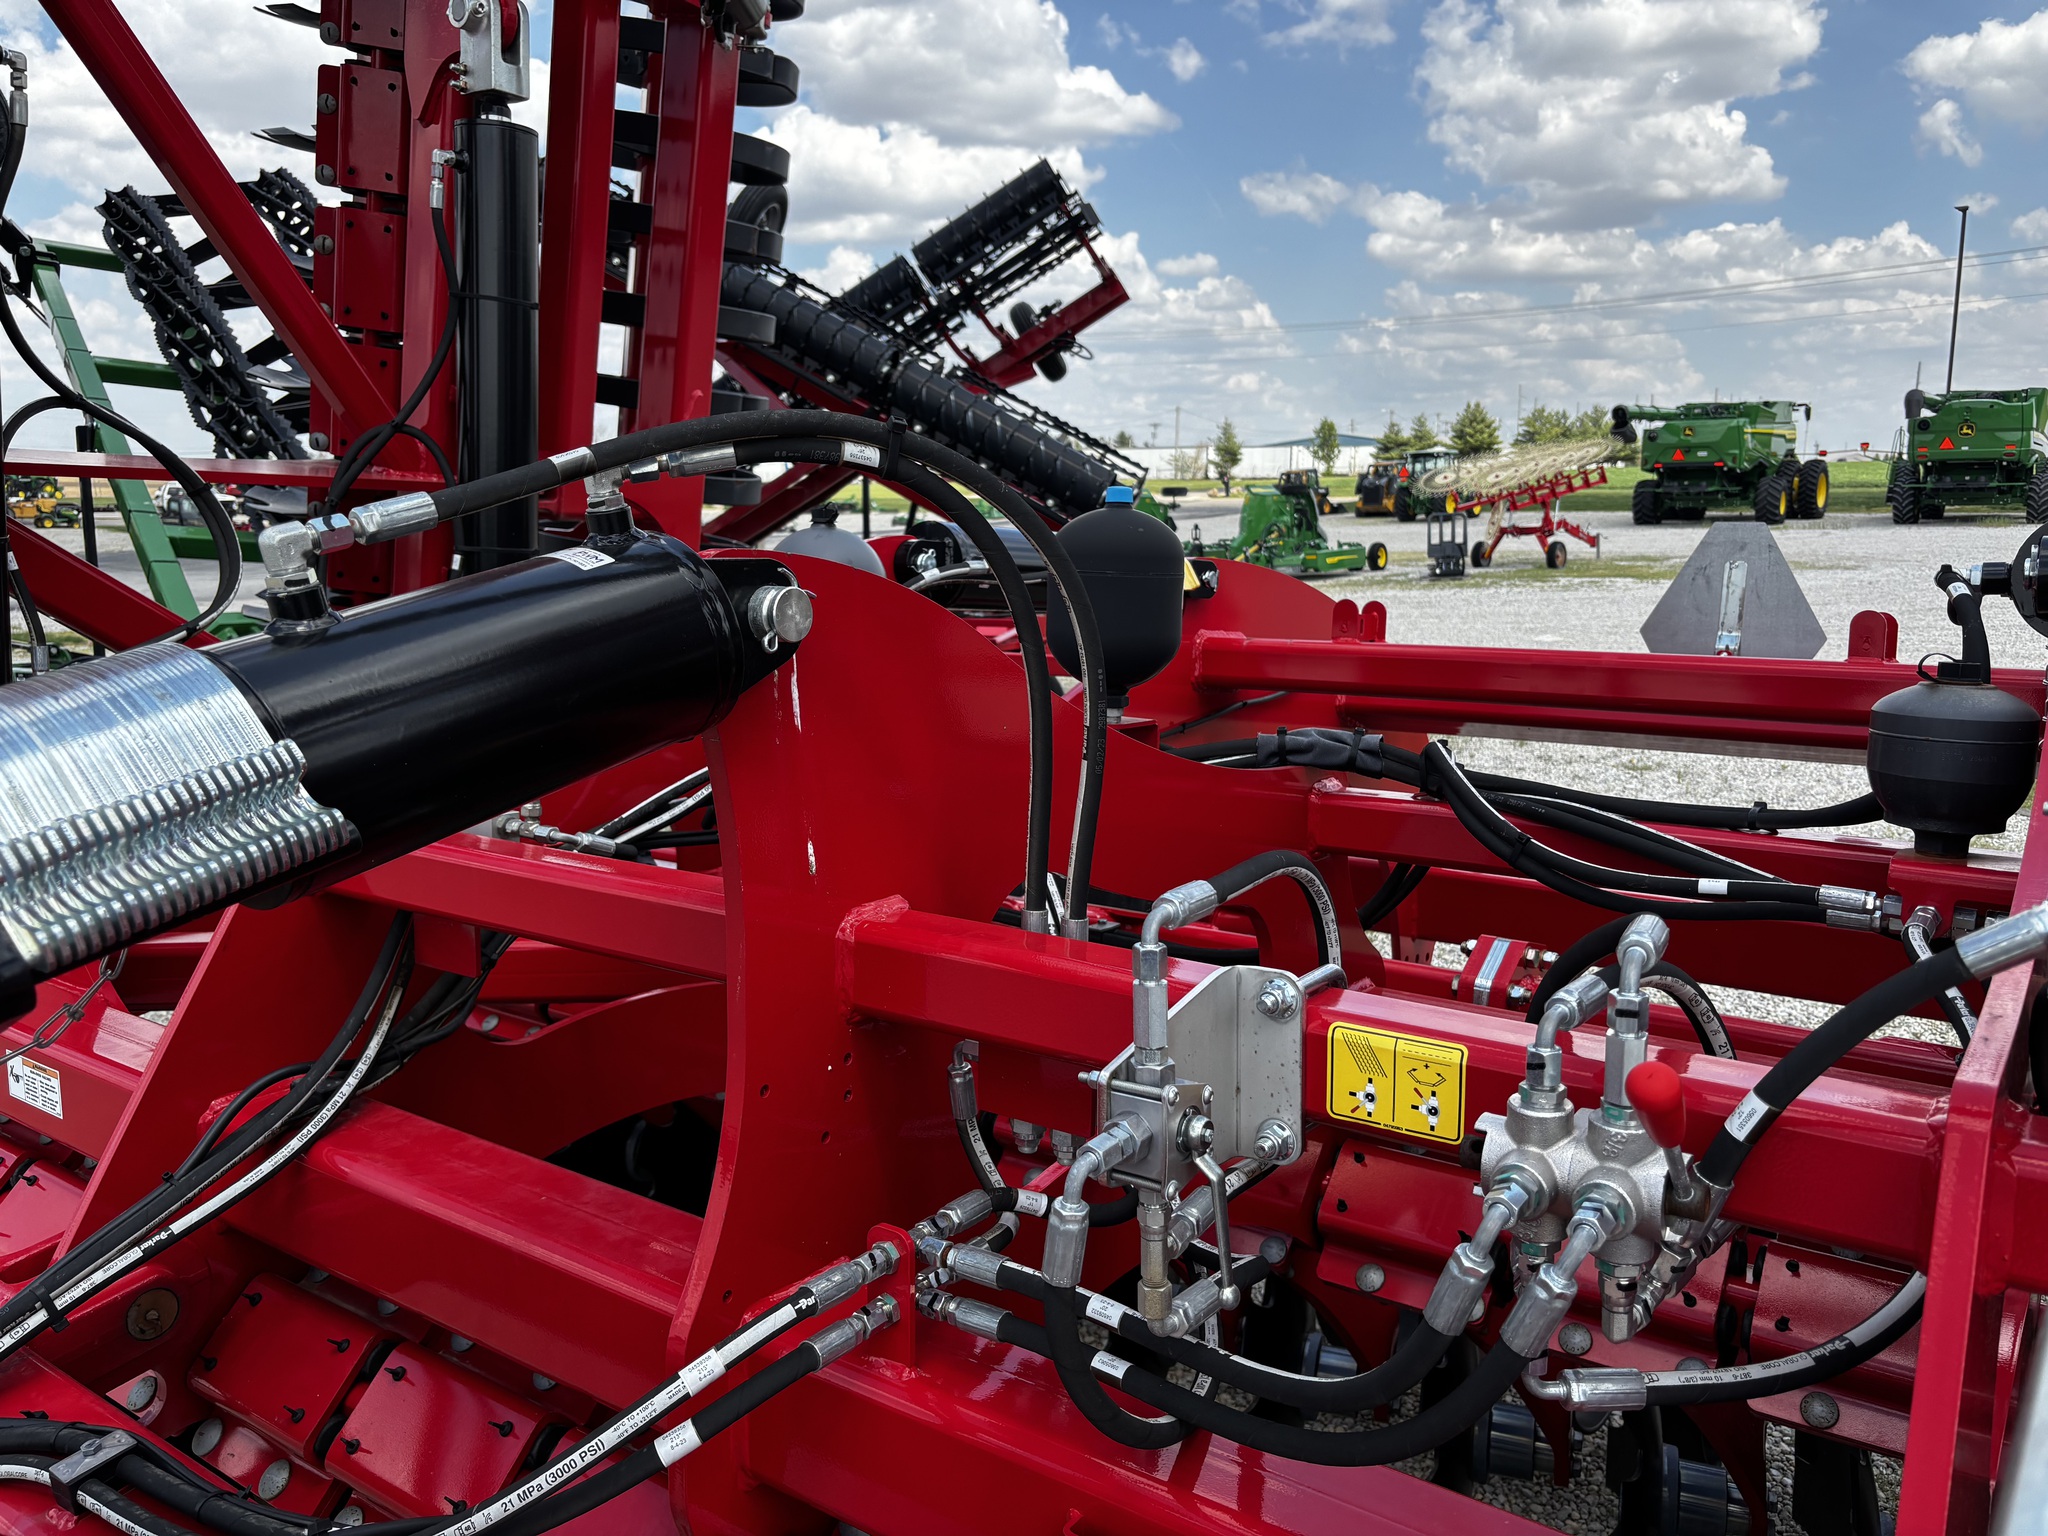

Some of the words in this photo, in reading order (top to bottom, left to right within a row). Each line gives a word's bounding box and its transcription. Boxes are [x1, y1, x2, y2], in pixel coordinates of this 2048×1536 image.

[1718, 1042, 1730, 1054] 21
[339, 1090, 347, 1101] 21
[328, 1099, 340, 1112] MPa
[310, 1110, 329, 1129] (3000
[968, 1119, 977, 1132] MP
[297, 1129, 313, 1144] PSI)
[971, 1133, 981, 1144] 21
[140, 1232, 168, 1250] Parker
[103, 1249, 139, 1275] GLOBALCORE
[1809, 1340, 1846, 1359] Parker
[1760, 1353, 1808, 1371] GLOBALCORE
[1732, 1372, 1752, 1381] 387-6
[667, 1388, 682, 1400] MADE
[627, 1414, 636, 1423] TO
[636, 1400, 656, 1417] +100°C
[501, 1500, 514, 1513] 21
[517, 1483, 543, 1503] MPa
[544, 1459, 578, 1486] (3000
[579, 1438, 606, 1463] PSI)
[115, 1518, 125, 1530] 21
[125, 1523, 140, 1536] MPa
